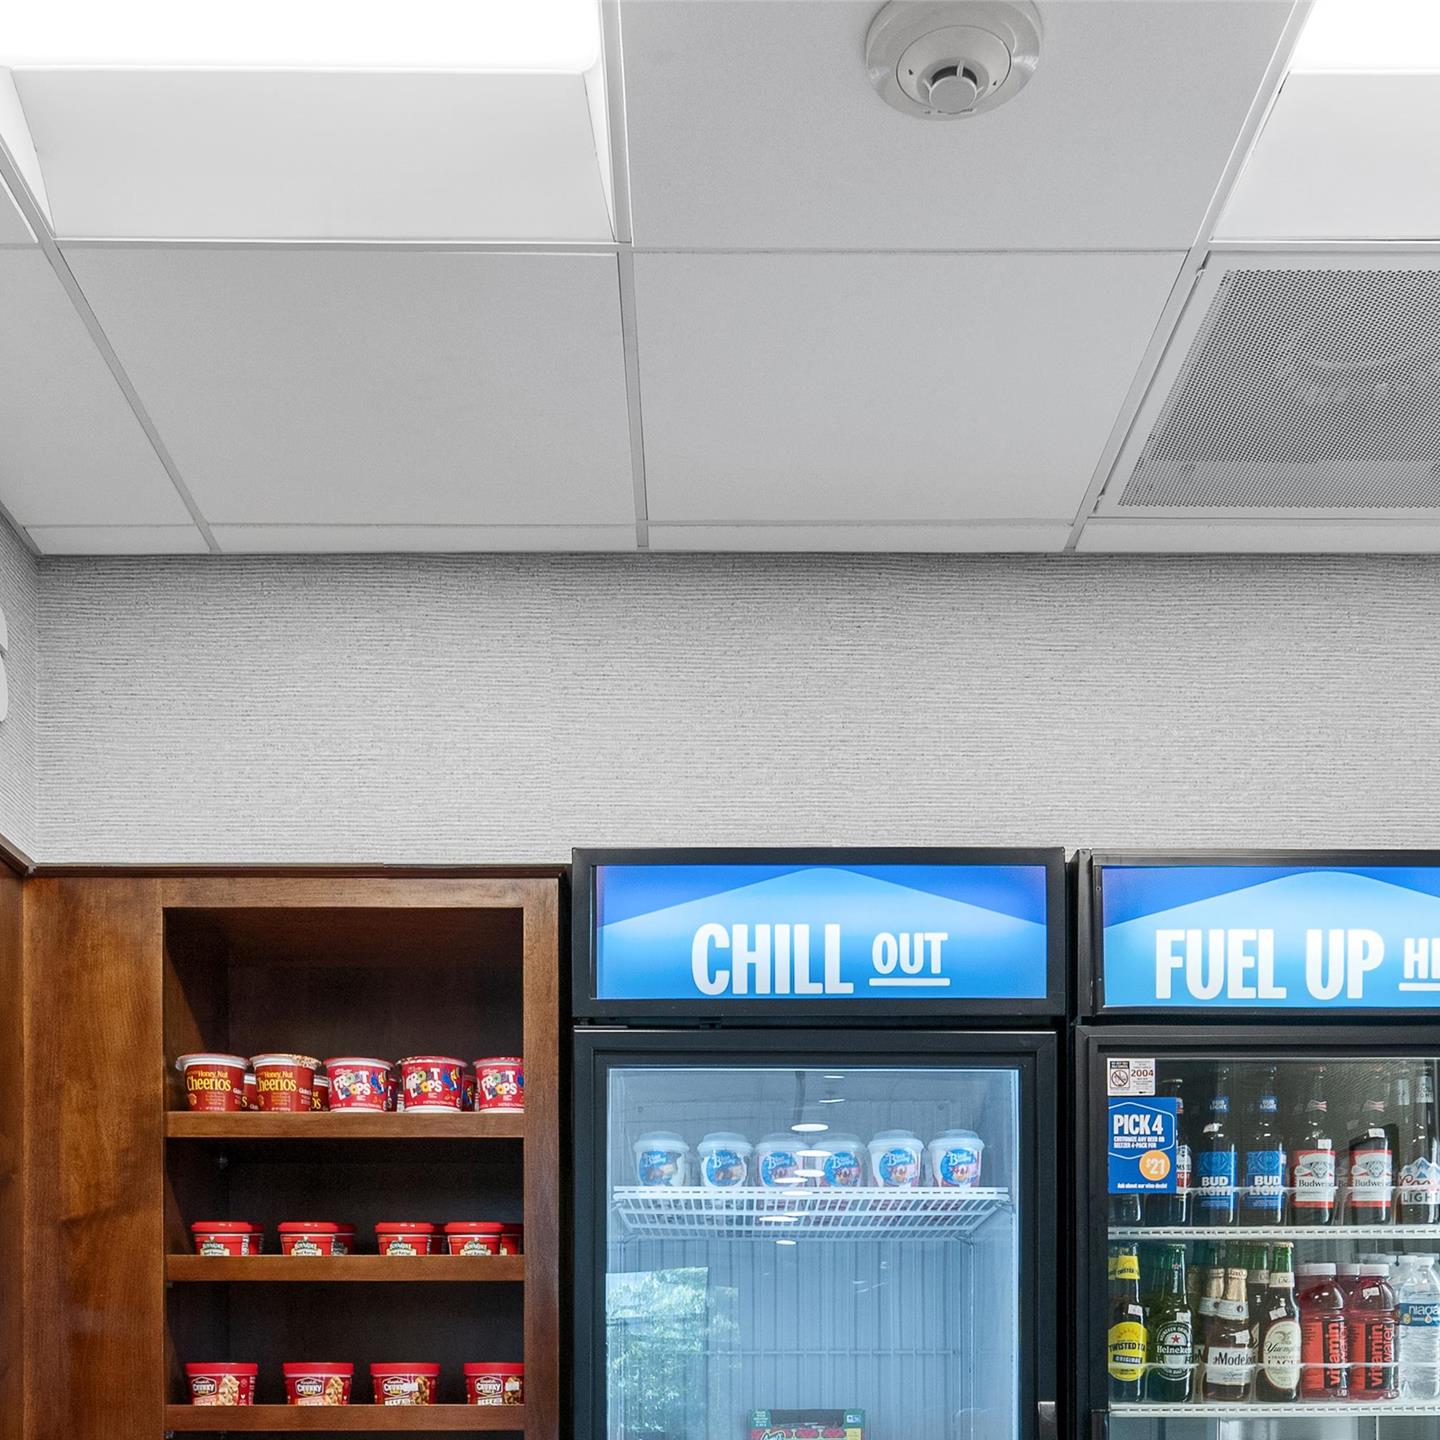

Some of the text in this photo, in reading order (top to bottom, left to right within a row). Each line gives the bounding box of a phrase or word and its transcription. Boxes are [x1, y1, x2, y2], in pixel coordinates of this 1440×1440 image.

[691, 922, 949, 996] CHILL OUT
[1155, 929, 1287, 1000] FUEL
[1305, 929, 1385, 1000] UP
[217, 1070, 228, 1079] Nut
[282, 1071, 294, 1079] Nut
[1131, 1069, 1154, 1077] 2004
[186, 1076, 232, 1092] Cheerios
[1113, 1113, 1164, 1135] PICK 4
[1201, 1176, 1228, 1186] BUD
[1254, 1175, 1280, 1186] BUD
[1403, 1192, 1438, 1203] LIGHT
[1114, 1355, 1142, 1364] ORIGINAL
[1218, 1351, 1256, 1366] Modelo
[1328, 1322, 1343, 1388] vitamin
[1370, 1322, 1384, 1388] vitamin
